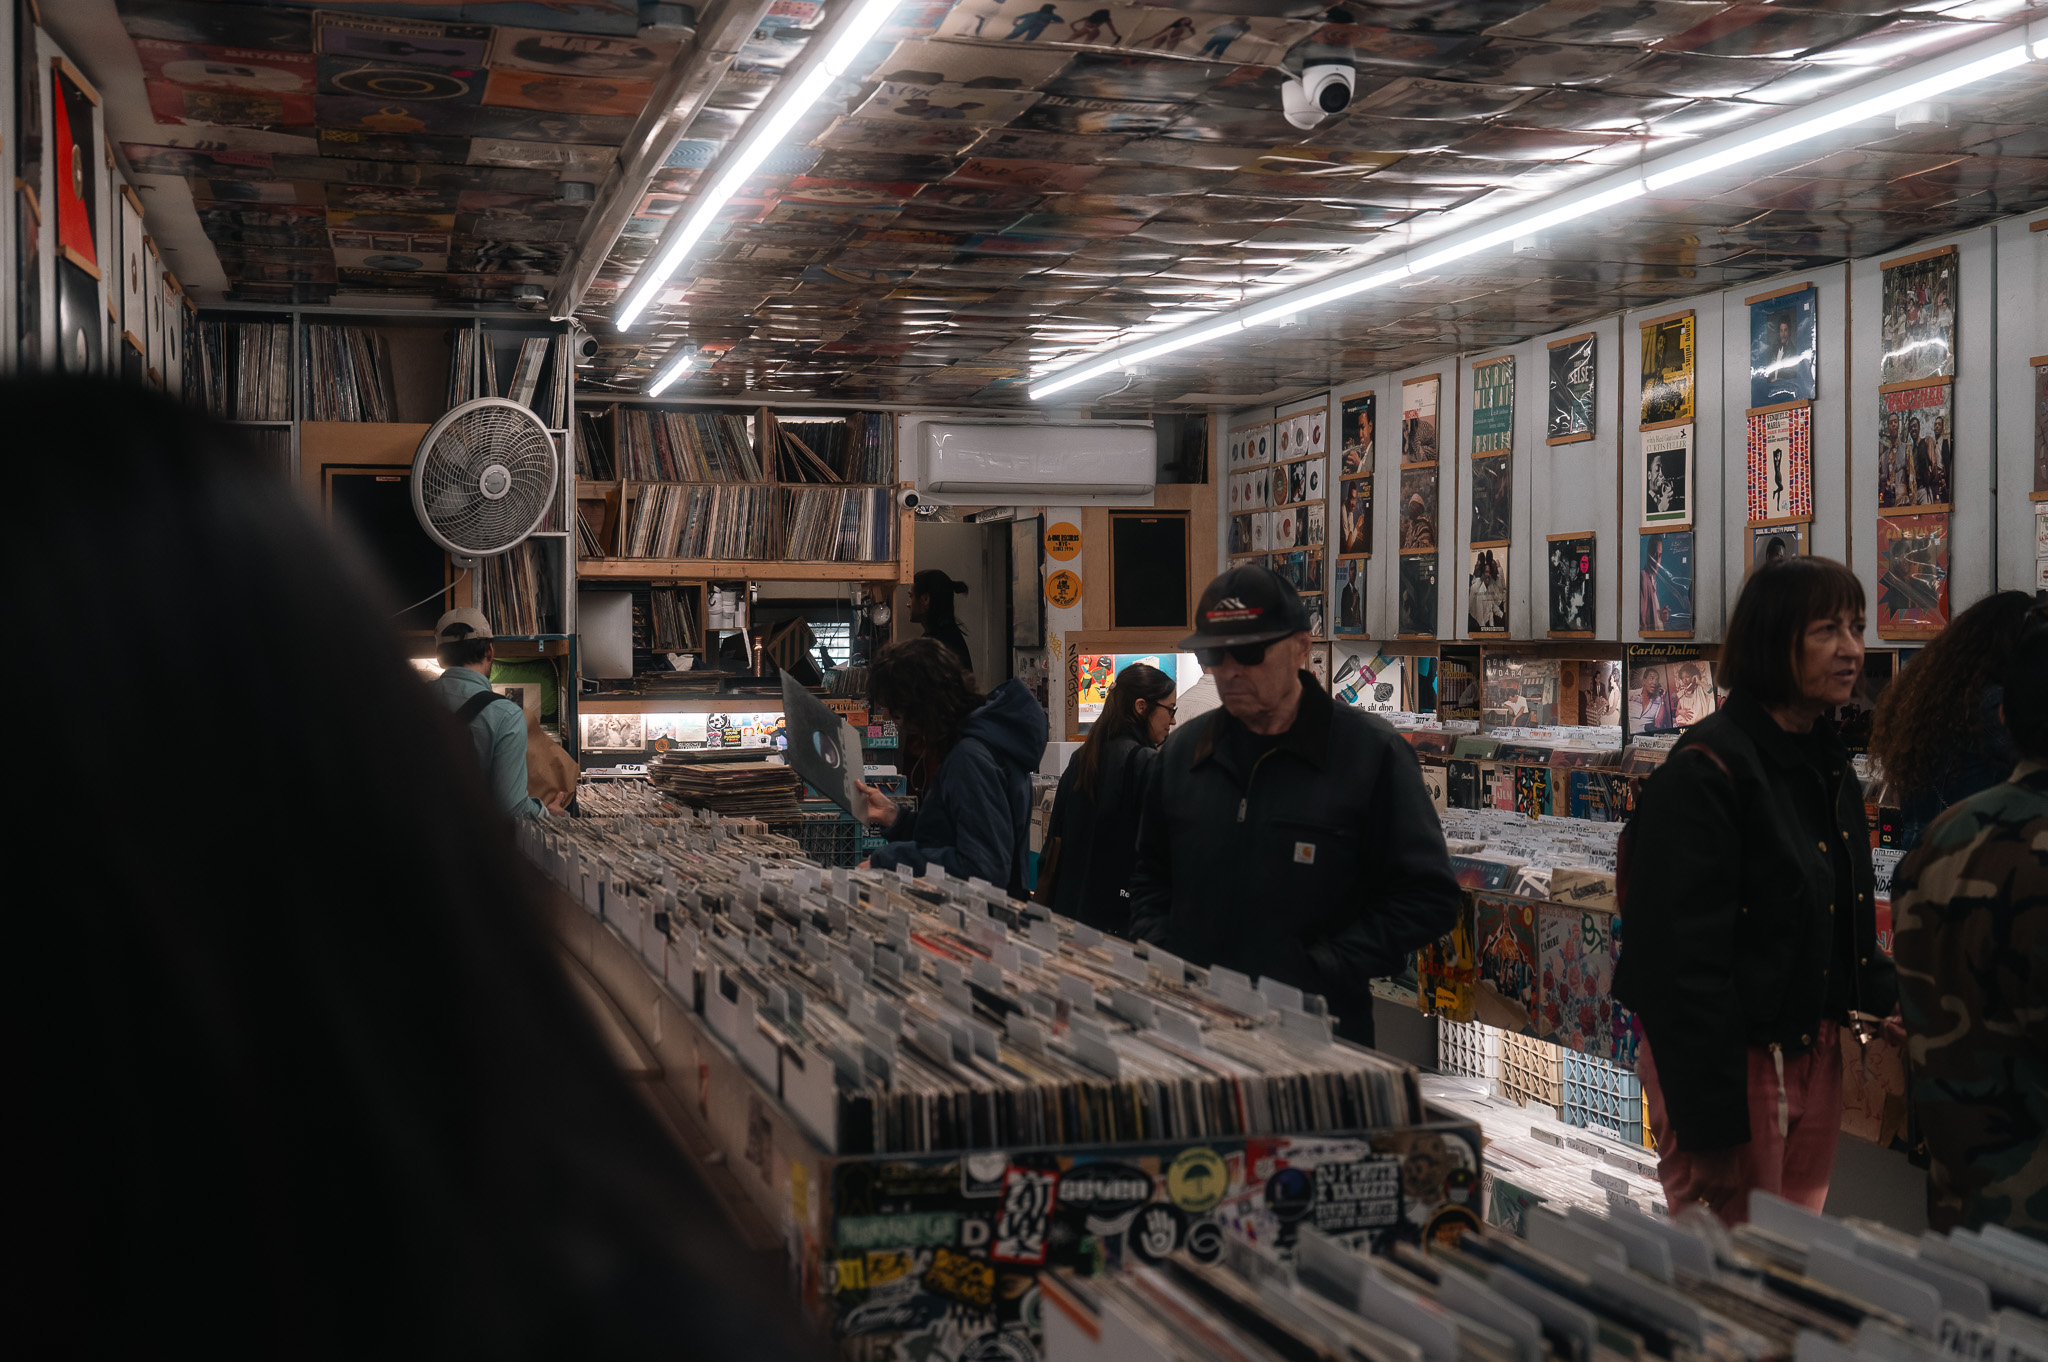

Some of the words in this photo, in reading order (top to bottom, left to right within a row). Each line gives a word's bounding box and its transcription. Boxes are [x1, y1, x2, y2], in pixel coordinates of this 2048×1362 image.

[224, 49, 313, 64] BRYANT
[1647, 442, 1665, 452] CURTIS
[1666, 440, 1687, 451] FULLER
[1629, 644, 1666, 655] Carlos
[1446, 830, 1463, 840] NATALIE
[1464, 831, 1475, 840] COLE
[1541, 935, 1559, 952] CARIBE
